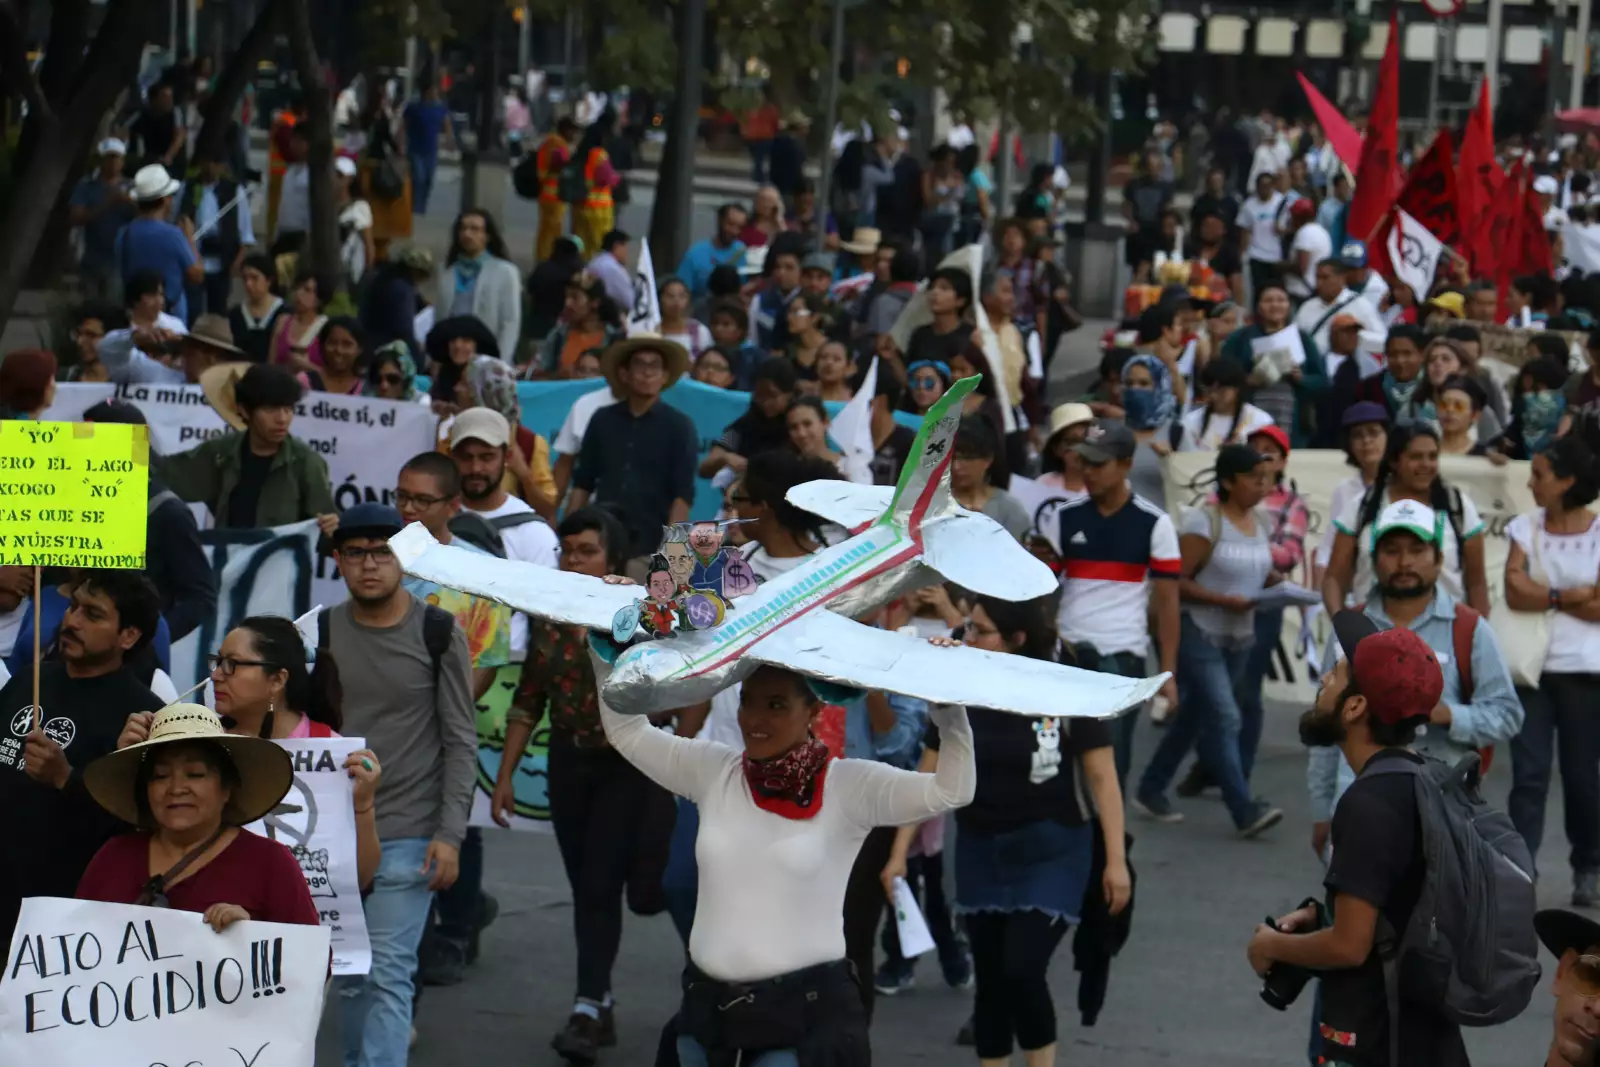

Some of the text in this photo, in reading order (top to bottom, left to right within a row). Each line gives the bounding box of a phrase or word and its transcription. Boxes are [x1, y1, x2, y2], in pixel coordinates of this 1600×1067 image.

[311, 401, 349, 421] dice
[379, 409, 396, 427] el
[48, 457, 72, 470] EL
[86, 459, 133, 472] LAGO
[39, 509, 74, 522] QUE
[81, 510, 105, 523] SE
[287, 750, 337, 772] HA
[12, 920, 184, 979] ALTO AL
[25, 937, 286, 1033] ECOCIDIO!!!
